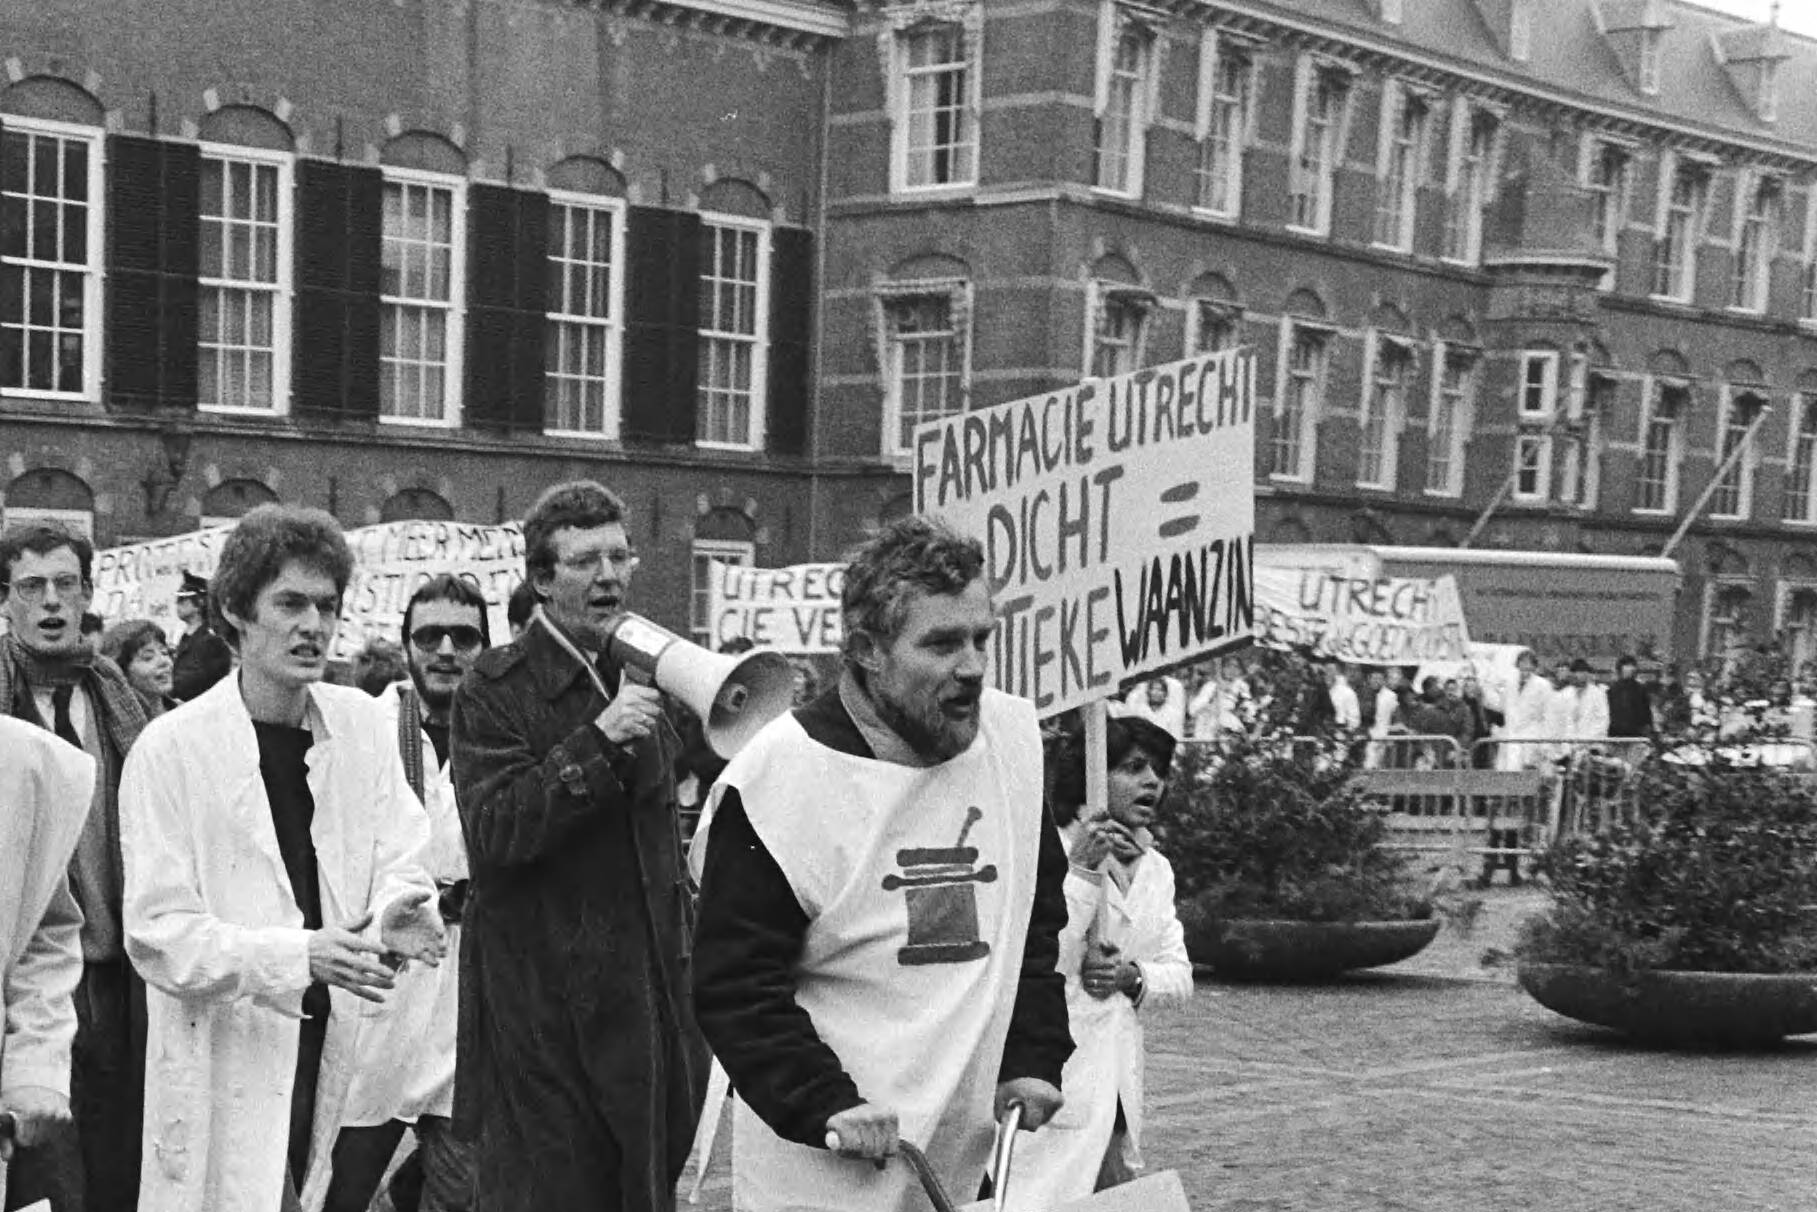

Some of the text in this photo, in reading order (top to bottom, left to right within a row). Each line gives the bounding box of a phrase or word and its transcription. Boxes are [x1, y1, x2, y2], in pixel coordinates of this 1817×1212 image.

[916, 384, 1097, 514] FARMACIE
[987, 464, 1124, 596] DICHT
[1114, 531, 1254, 671] WAANZIN
